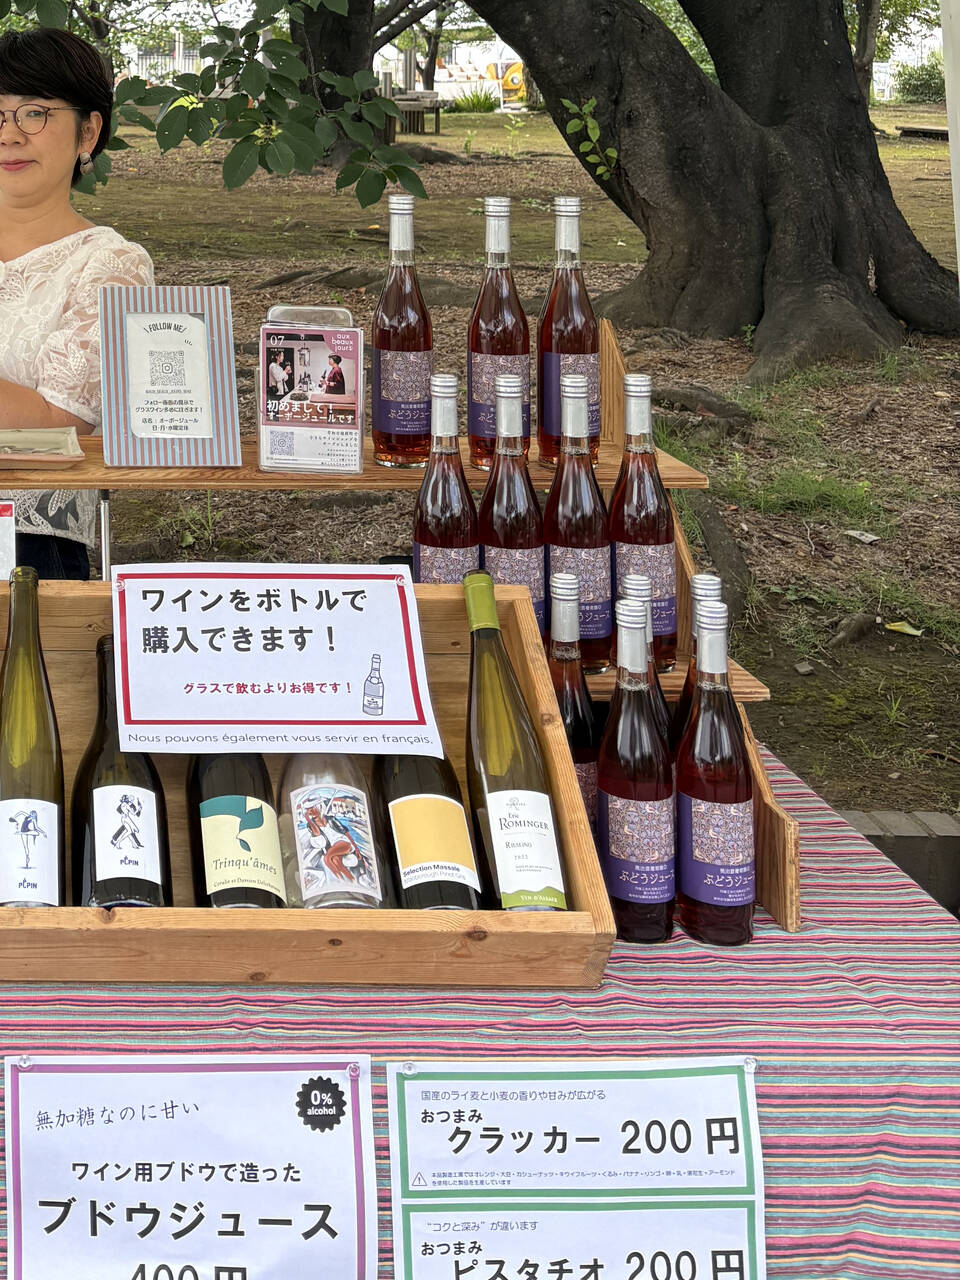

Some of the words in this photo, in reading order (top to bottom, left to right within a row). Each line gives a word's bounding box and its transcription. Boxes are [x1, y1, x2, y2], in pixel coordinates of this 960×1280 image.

[148, 322, 172, 332] FOLLOW
[270, 335, 285, 346] 07
[331, 337, 353, 345] beaux
[266, 400, 334, 414] 初めまして！
[388, 408, 431, 420] ぶどうジュー
[141, 588, 368, 613] ワインをボトルで
[142, 625, 336, 655] 購入できます！
[182, 681, 352, 696] グラスで飲むよりお得です！
[128, 733, 161, 743] Nous
[165, 735, 219, 744] pouvons
[222, 732, 289, 744] également
[291, 734, 322, 743] vous
[325, 734, 359, 743] servir
[362, 735, 379, 744] en
[382, 733, 434, 745] français.
[403, 865, 433, 878] Selection
[703, 871, 756, 888] ぶどうジュー
[310, 1090, 333, 1106] 0%
[421, 1088, 607, 1102] 国産のライ麦と小麦の香りや甘みが広がる
[35, 1099, 201, 1131] 無加糖なのに甘い
[306, 1105, 337, 1117] alcohol
[421, 1108, 484, 1124] おつまみ
[448, 1125, 601, 1155] クラッカー
[620, 1119, 693, 1155] 200
[705, 1116, 741, 1156] 円
[71, 1161, 302, 1184] ワイン用ブドウで造った
[37, 1196, 339, 1241] ブドウジュース
[421, 1240, 483, 1256] おつまみ
[454, 1258, 605, 1280] ピスタチオ
[626, 1251, 698, 1280] 200
[711, 1250, 745, 1280] 円
